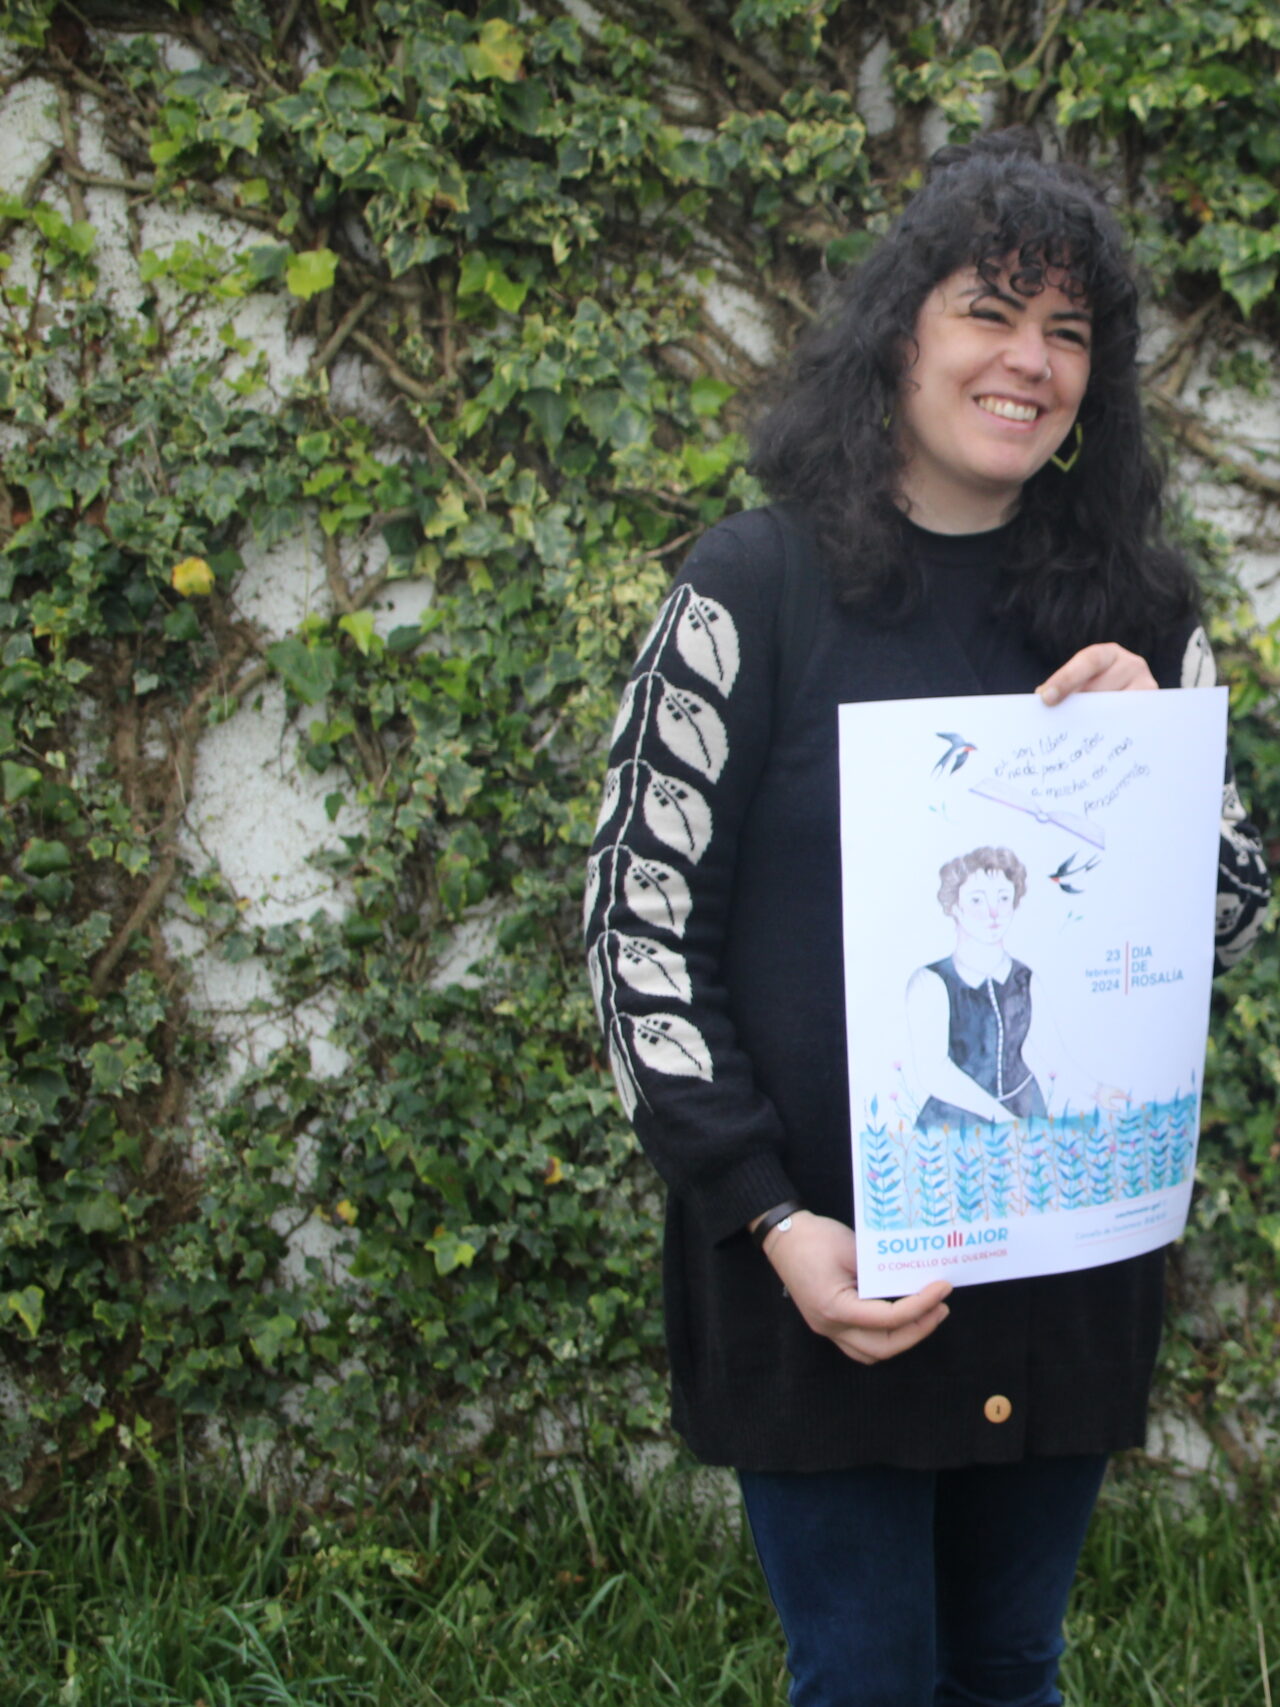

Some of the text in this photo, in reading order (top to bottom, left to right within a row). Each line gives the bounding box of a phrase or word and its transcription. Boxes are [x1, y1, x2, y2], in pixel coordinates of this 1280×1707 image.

[1106, 950, 1121, 962] 23
[1131, 945, 1153, 960] DIA
[1131, 960, 1148, 974] DE
[1091, 979, 1120, 993] 2024
[877, 1262, 886, 1272] O
[888, 1257, 939, 1271] CONCELLO
[941, 1255, 959, 1266] QUE
